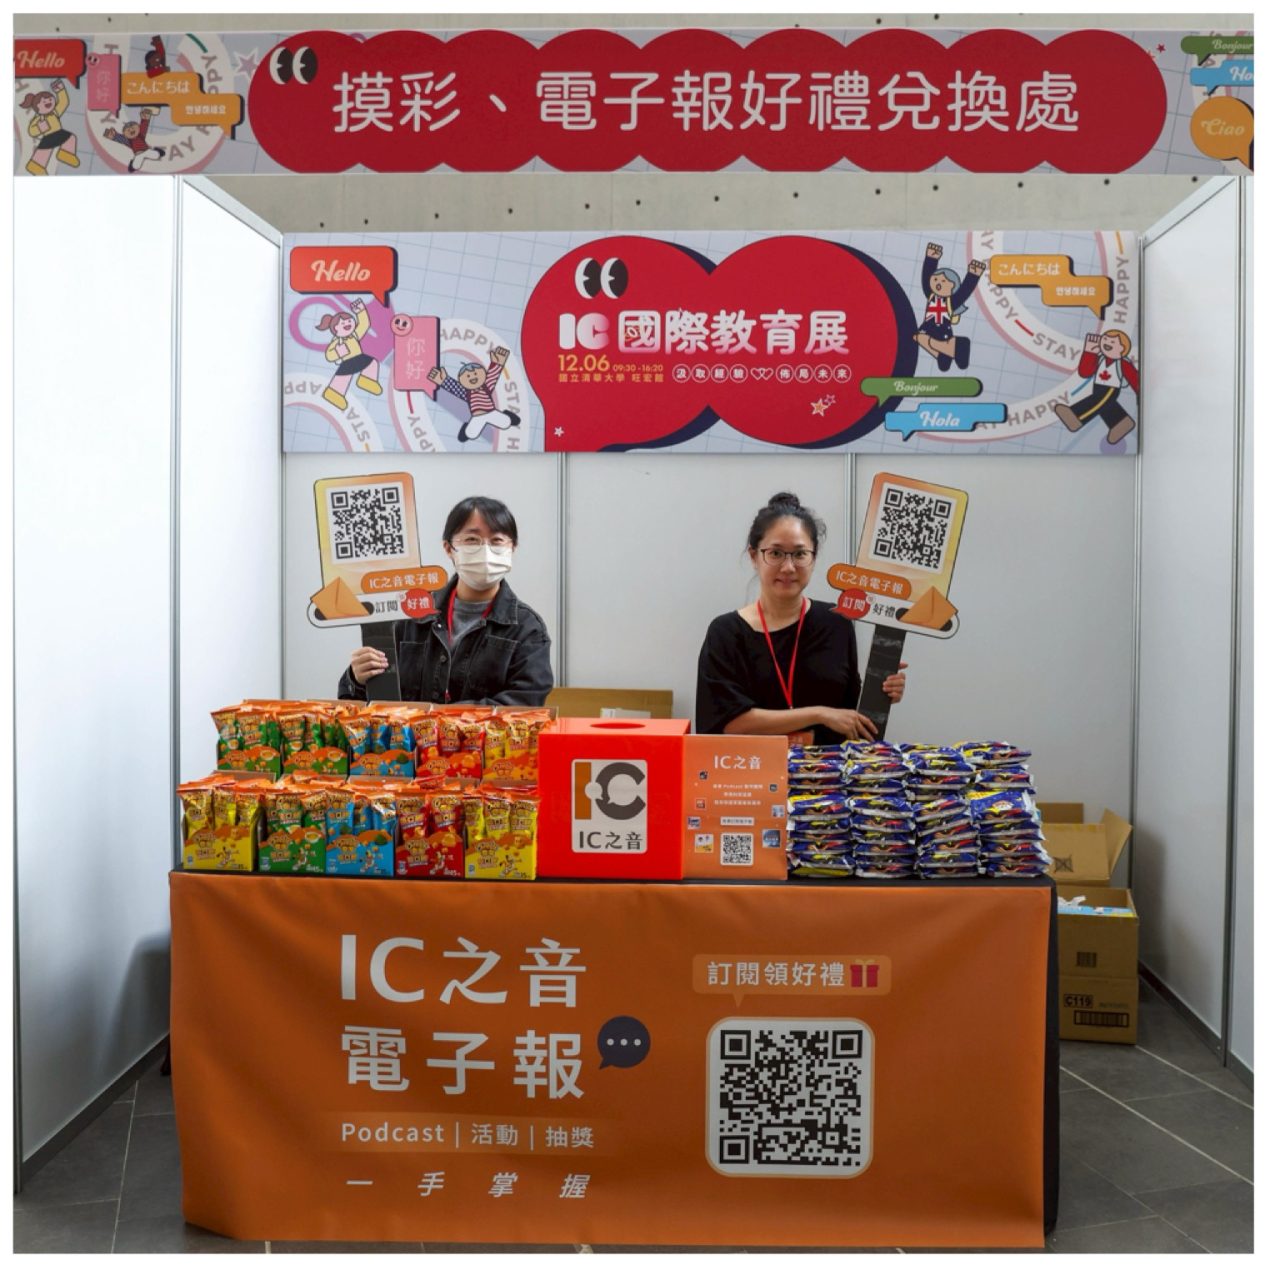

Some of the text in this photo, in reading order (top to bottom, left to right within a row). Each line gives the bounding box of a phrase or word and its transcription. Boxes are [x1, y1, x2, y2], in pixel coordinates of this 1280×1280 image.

[1211, 38, 1254, 53] Bonjour
[17, 49, 65, 69] Hello
[127, 79, 191, 95] こんにちは
[185, 104, 227, 115] 안녕하세요
[332, 68, 1080, 134] 摸彩、電子報好禮兌換處
[1200, 118, 1245, 136] Ciao
[310, 260, 370, 282] Hello
[998, 262, 1061, 276] こんにちは
[1055, 286, 1096, 297] 안녕하세요
[1113, 256, 1130, 324] HAPPY
[559, 308, 850, 355] IC國際教育展
[1033, 332, 1081, 361] STAY
[406, 337, 426, 380] 你好
[558, 354, 610, 372] 12.06
[558, 373, 625, 383] 國立清華大學
[894, 380, 938, 396] Bonjour
[919, 410, 961, 428] Hola
[369, 572, 440, 589] IC之音電子報
[835, 570, 904, 595] IC之音電子報
[375, 596, 430, 614] 訂閱 好禮
[842, 596, 897, 618] 訂閱 好禮
[714, 755, 763, 770] IC之音
[579, 831, 643, 851] IC之音
[340, 933, 587, 1009] IC之音
[706, 960, 845, 988] 訂閱領好禮
[1065, 995, 1092, 1007] C119
[340, 1024, 585, 1100] 電子報
[341, 1122, 595, 1150] Podcast 活動 抽獎
